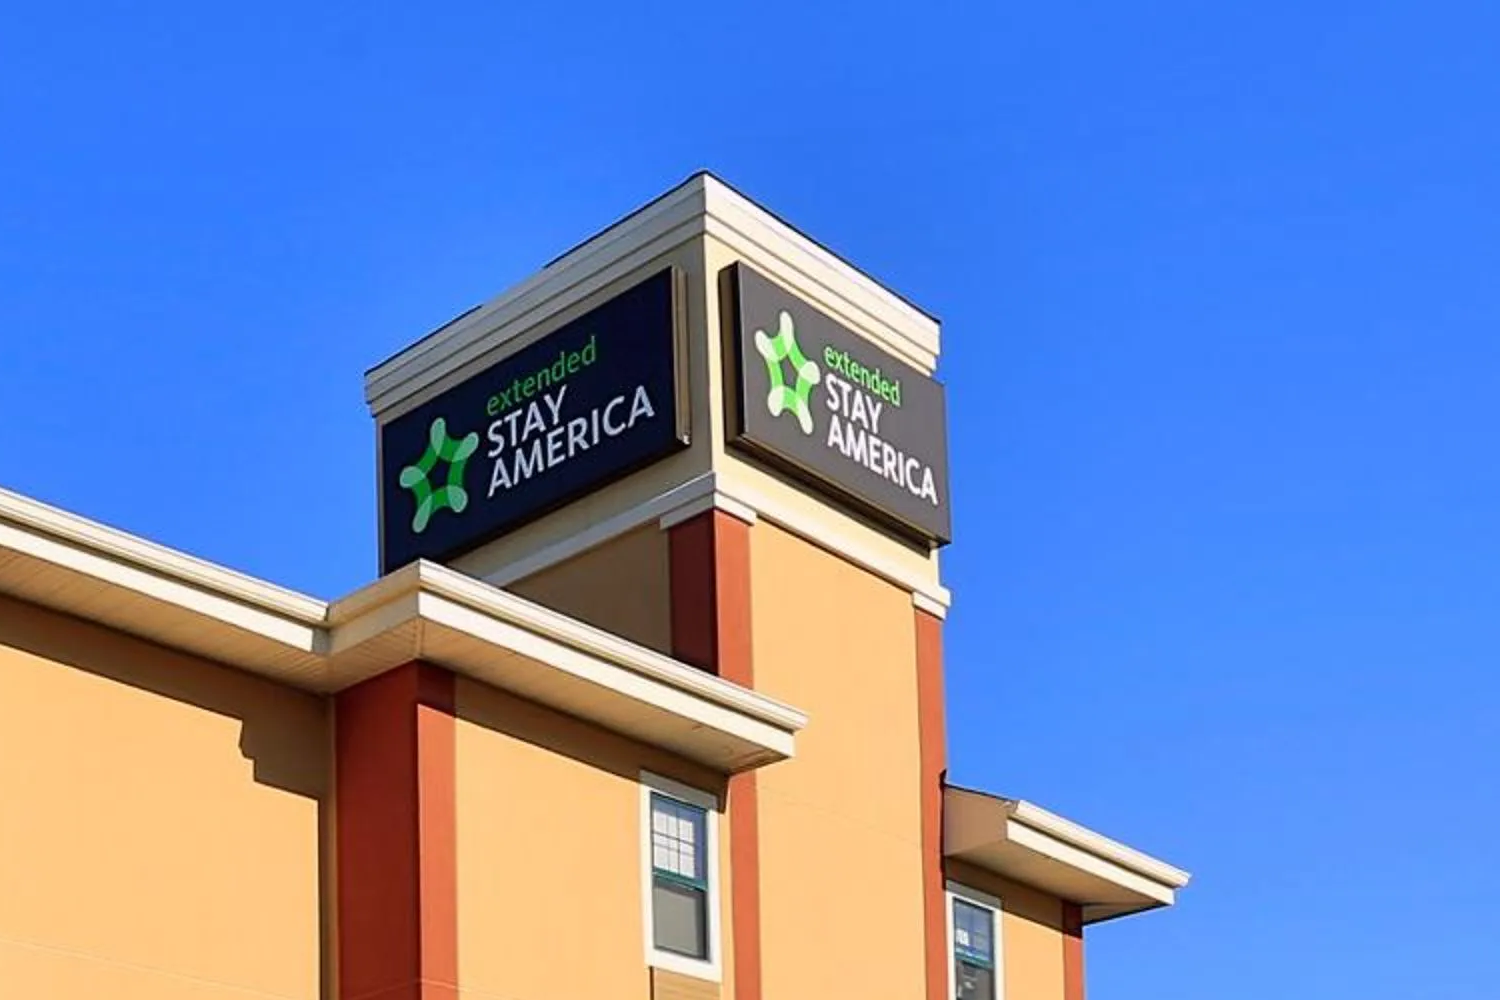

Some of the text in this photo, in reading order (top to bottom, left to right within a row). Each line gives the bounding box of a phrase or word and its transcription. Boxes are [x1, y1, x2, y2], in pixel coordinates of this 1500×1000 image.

[486, 336, 597, 416] extended
[824, 345, 901, 408] extended
[825, 373, 884, 434] STAY
[487, 385, 568, 458] STAY
[487, 386, 655, 498] AMERICA
[828, 422, 938, 506] AMERICA
